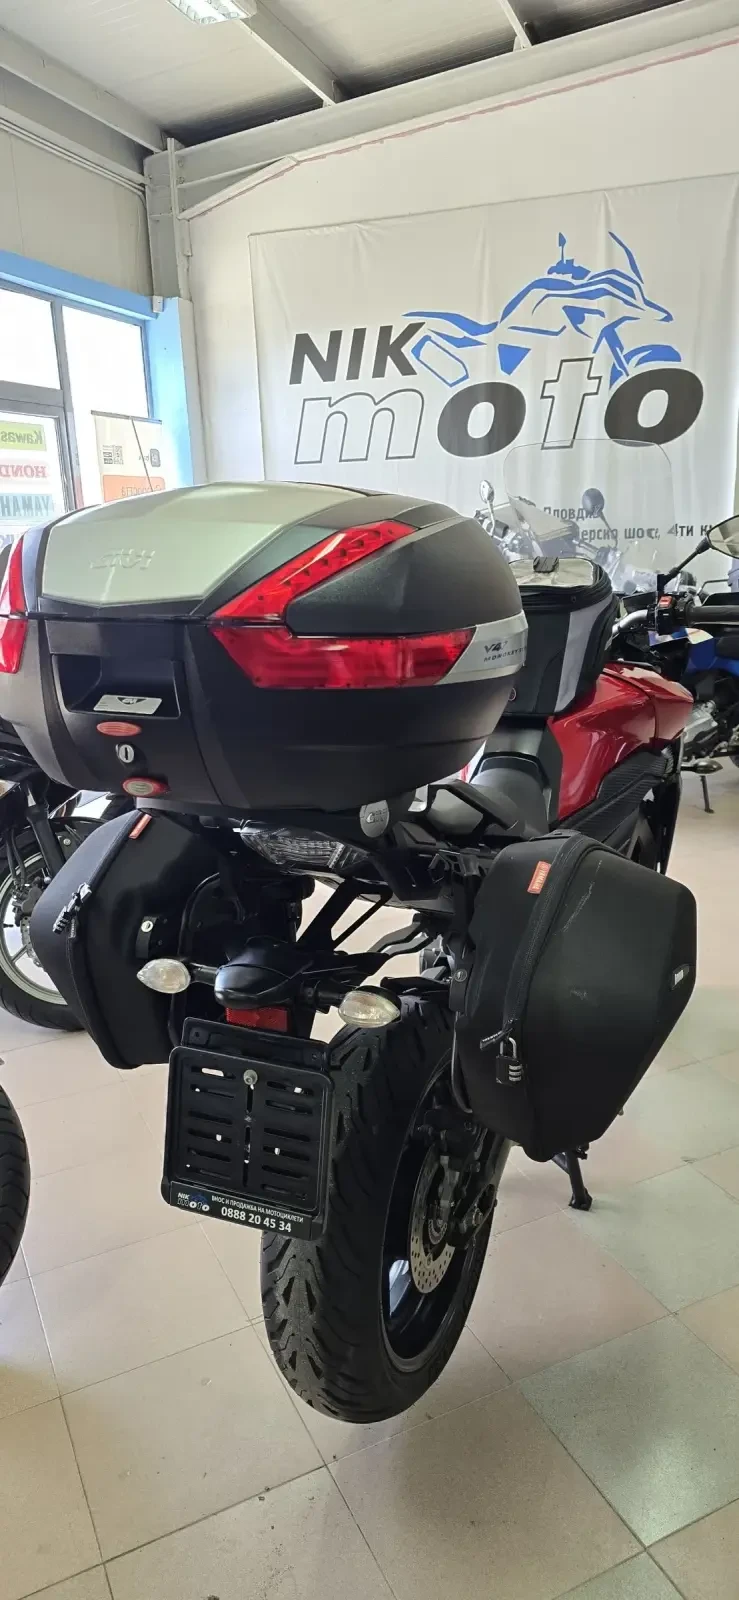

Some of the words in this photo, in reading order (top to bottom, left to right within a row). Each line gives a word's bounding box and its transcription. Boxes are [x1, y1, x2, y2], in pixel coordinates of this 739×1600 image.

[289, 321, 426, 386] NIK
[294, 356, 704, 465] moto
[211, 1195, 225, 1204] ВНОС
[229, 1199, 258, 1212] ПРОДАЖБА
[257, 1206, 265, 1214] НА
[265, 1208, 304, 1223] МОТОЦИКЛЕТИ
[221, 1206, 246, 1221] 0888
[248, 1213, 262, 1225] 20
[263, 1217, 276, 1229] 45
[278, 1221, 292, 1233] 34
